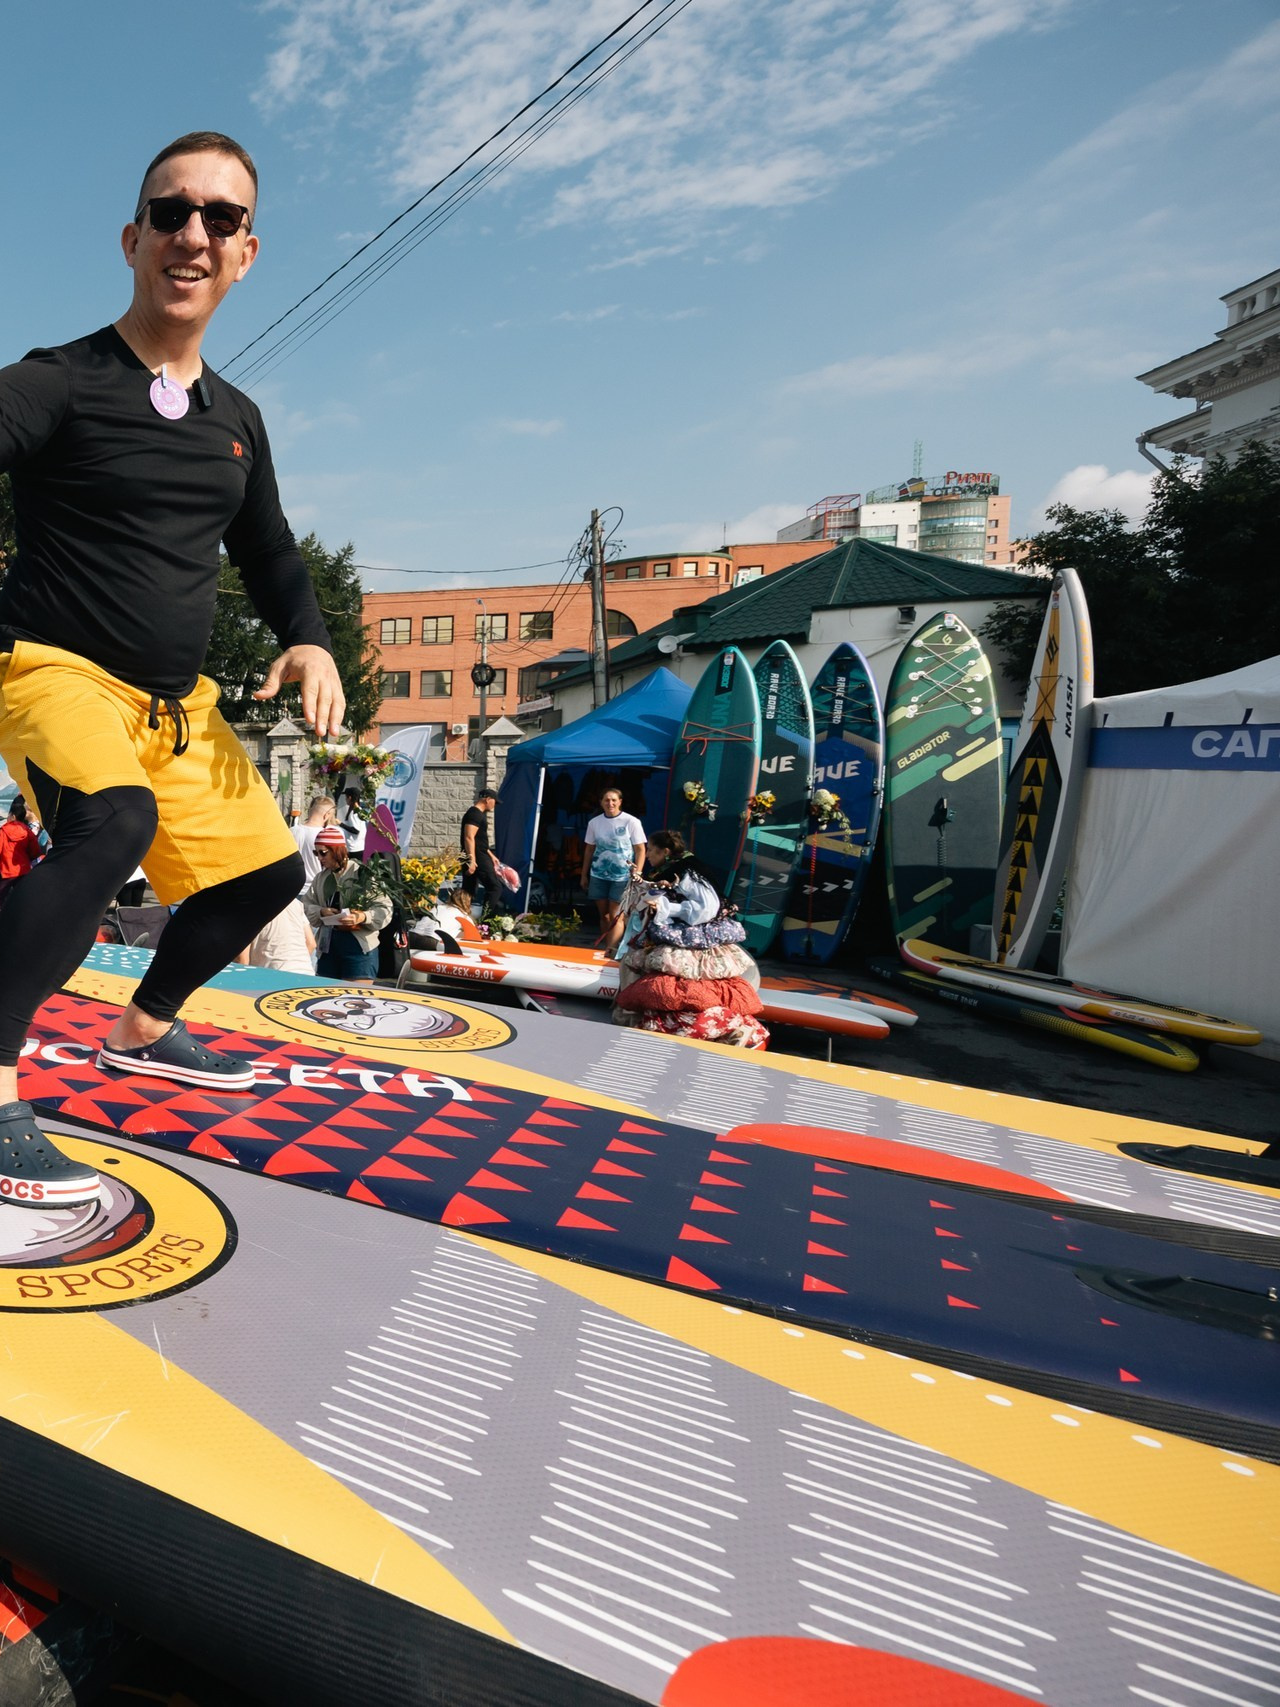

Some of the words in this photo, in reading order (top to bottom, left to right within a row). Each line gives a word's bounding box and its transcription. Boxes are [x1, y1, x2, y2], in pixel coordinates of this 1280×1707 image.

[1065, 676, 1074, 738] NAISH
[266, 991, 298, 1011] BUCK
[301, 988, 375, 998] TEETH
[246, 1060, 473, 1101] EETH
[19, 1233, 204, 1300] SPORTS
